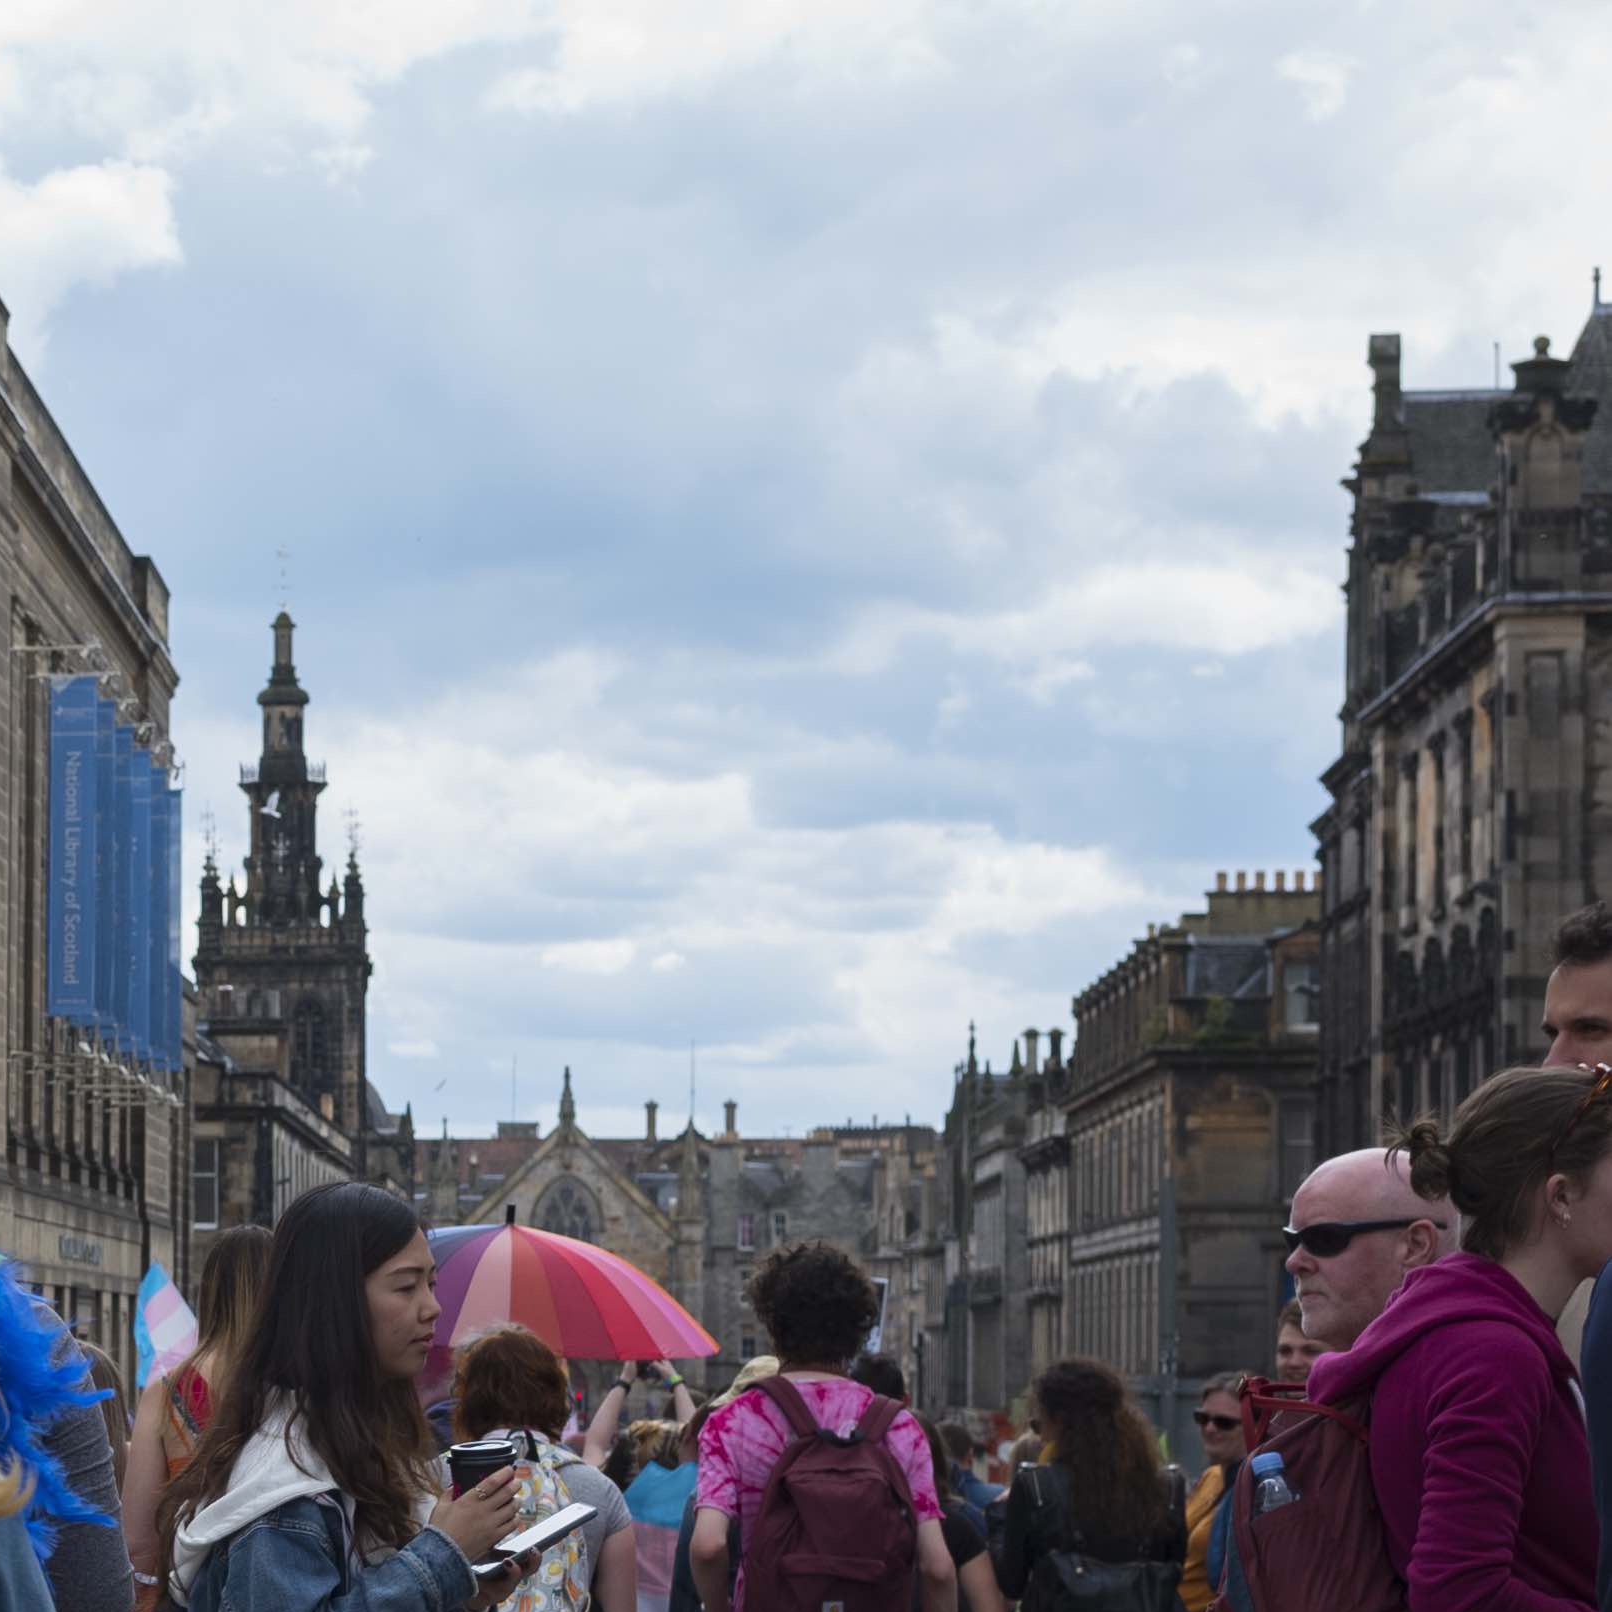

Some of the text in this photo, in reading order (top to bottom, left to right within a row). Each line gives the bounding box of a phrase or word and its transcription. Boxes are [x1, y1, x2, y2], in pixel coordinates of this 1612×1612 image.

[66, 751, 81, 822] National
[61, 827, 81, 886] Library
[64, 892, 81, 909] of
[63, 913, 81, 985] Scotland
